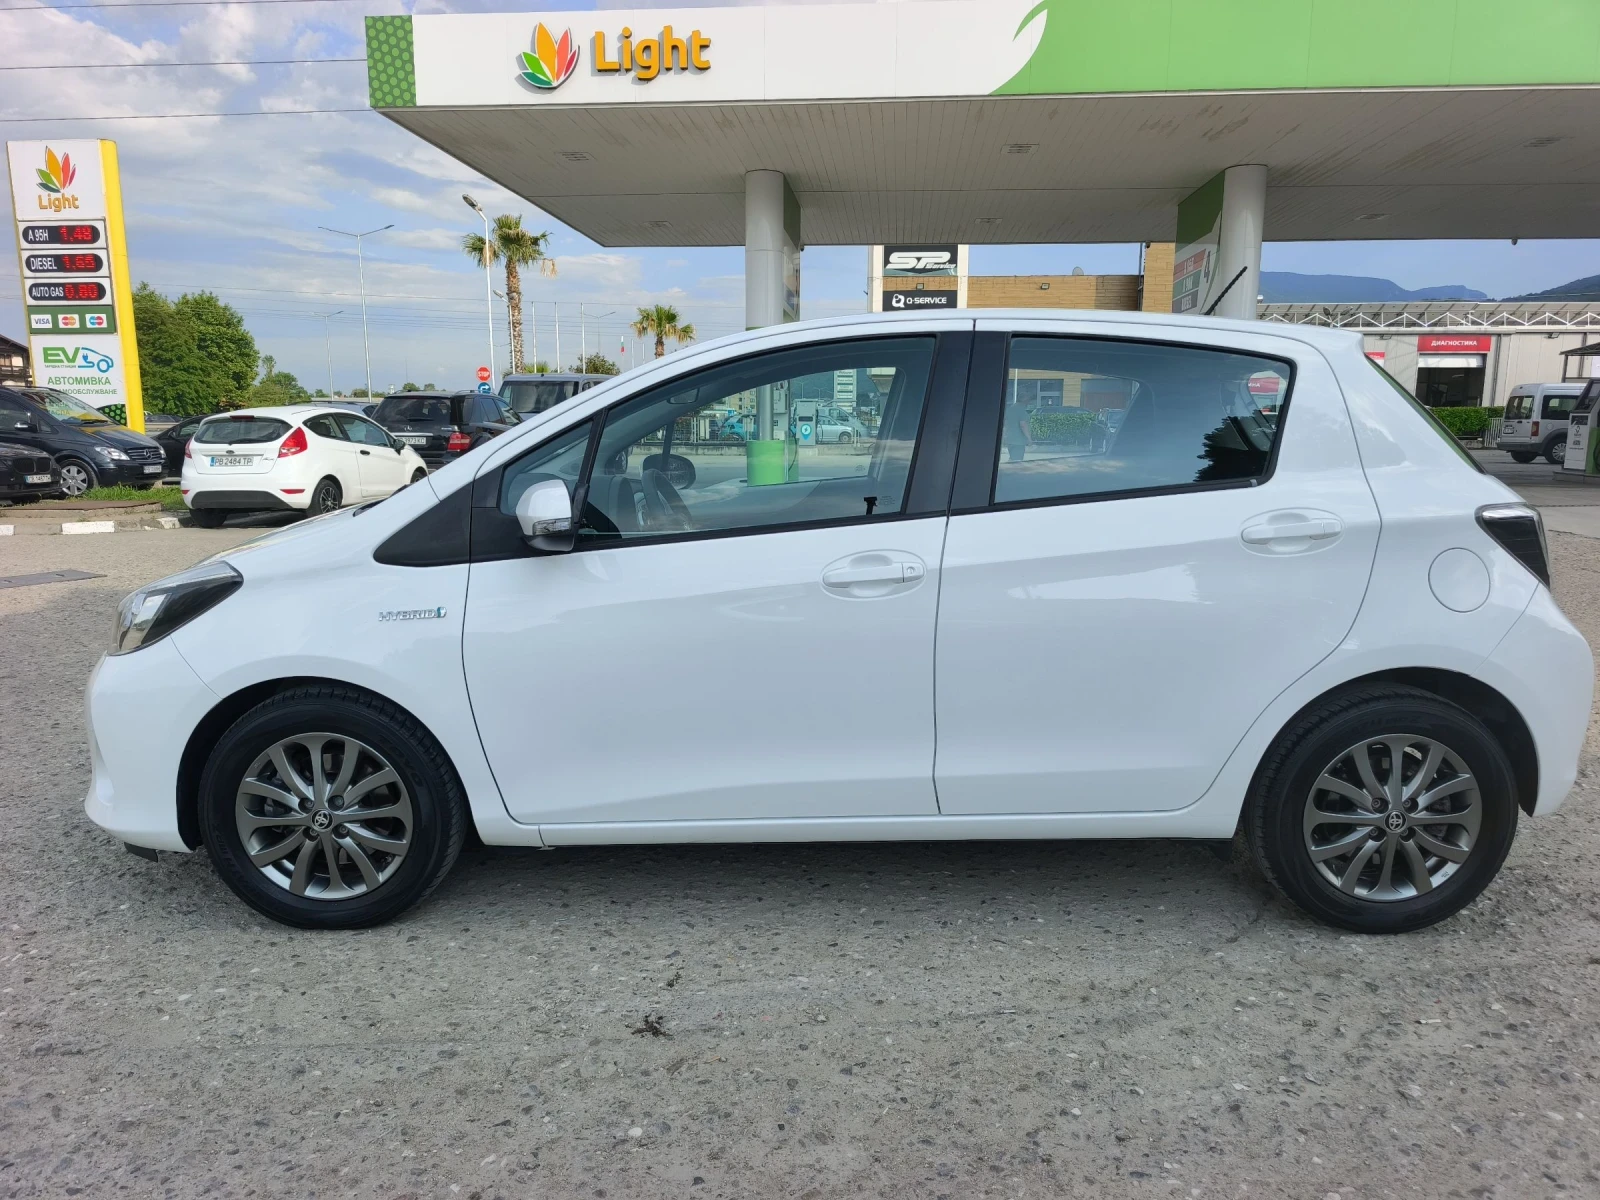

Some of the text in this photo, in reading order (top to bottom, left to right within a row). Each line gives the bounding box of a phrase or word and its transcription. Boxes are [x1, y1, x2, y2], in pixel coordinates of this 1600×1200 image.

[594, 25, 711, 80] Light
[38, 193, 80, 213] Light
[30, 257, 58, 270] DIESEL
[32, 286, 49, 297] AUTO
[50, 286, 64, 297] GAS
[43, 346, 81, 364] EV
[47, 376, 112, 386] АВТОМИВКА
[224, 457, 242, 466] 2484
[242, 457, 252, 465] TP
[378, 609, 436, 621] HYBRID
